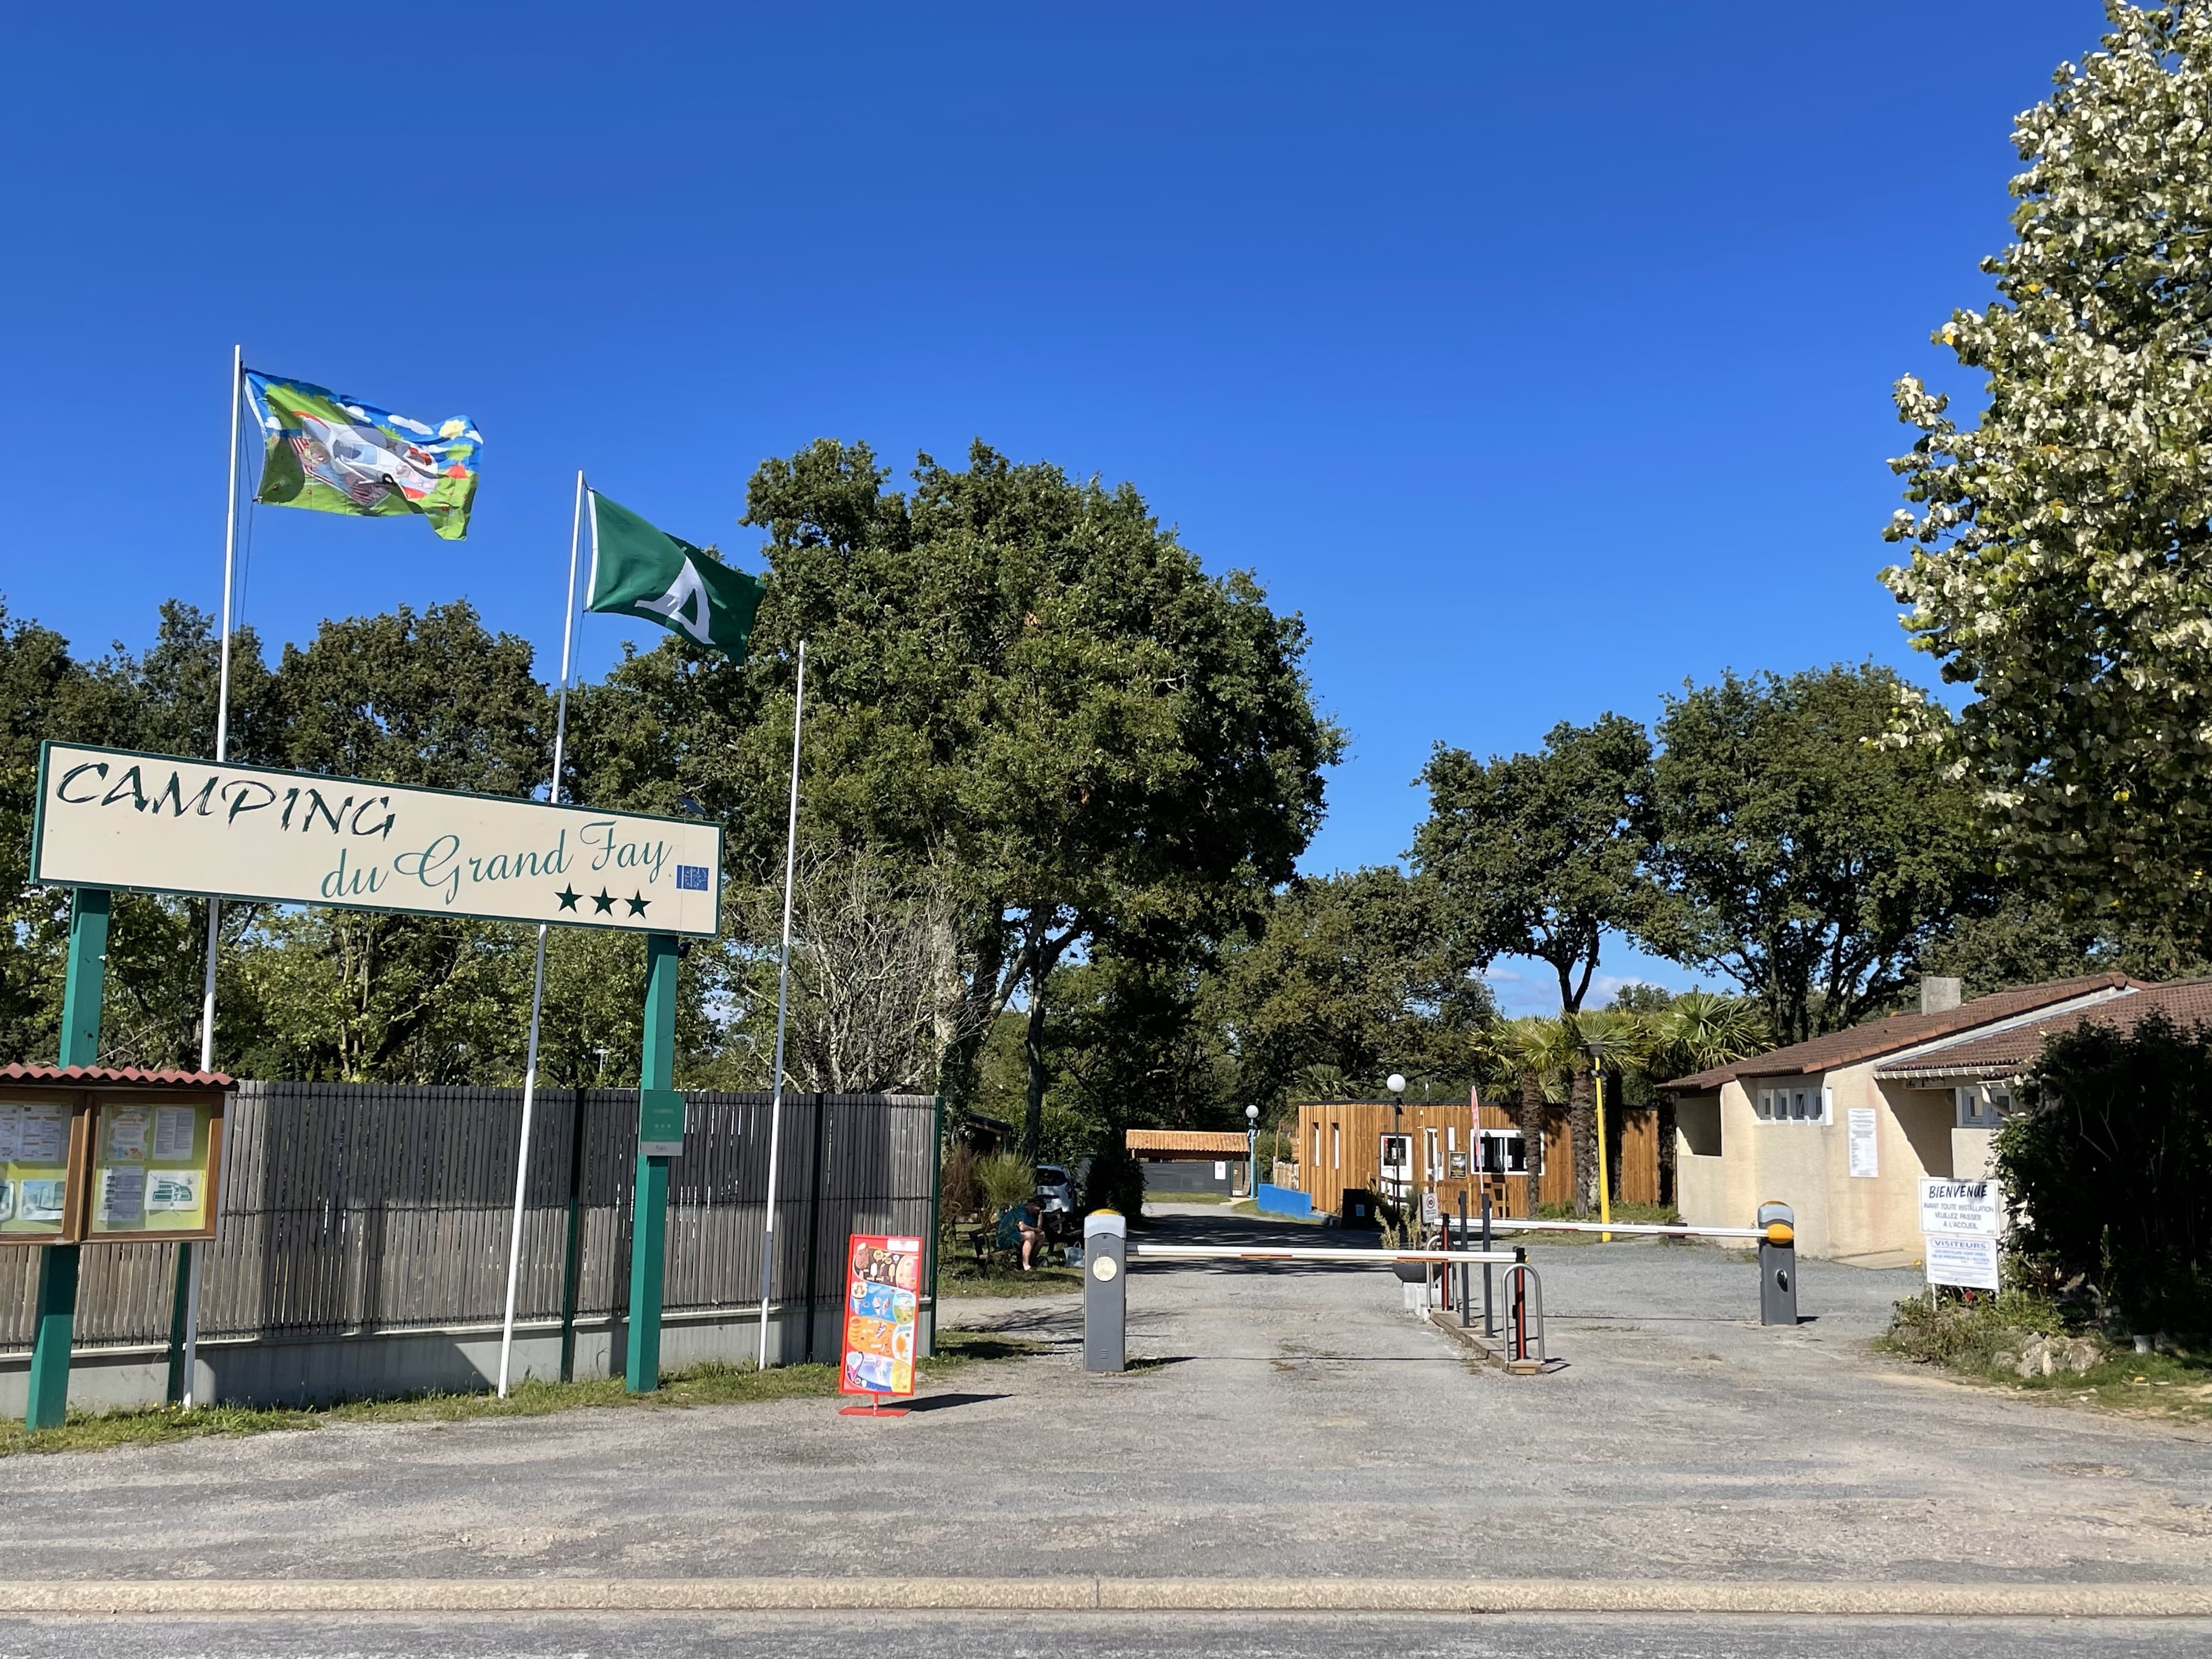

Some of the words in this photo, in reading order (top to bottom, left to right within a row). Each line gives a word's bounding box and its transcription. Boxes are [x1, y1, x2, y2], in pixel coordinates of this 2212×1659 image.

[57, 762, 396, 842] CAMPING
[321, 849, 389, 899] du
[394, 828, 574, 905] Grand
[580, 820, 673, 884] Fay
[1929, 1185, 1987, 1198] BIENVENUE
[1958, 1205, 1994, 1213] INSTALLATION
[1934, 1240, 1986, 1249] VISITEURS
